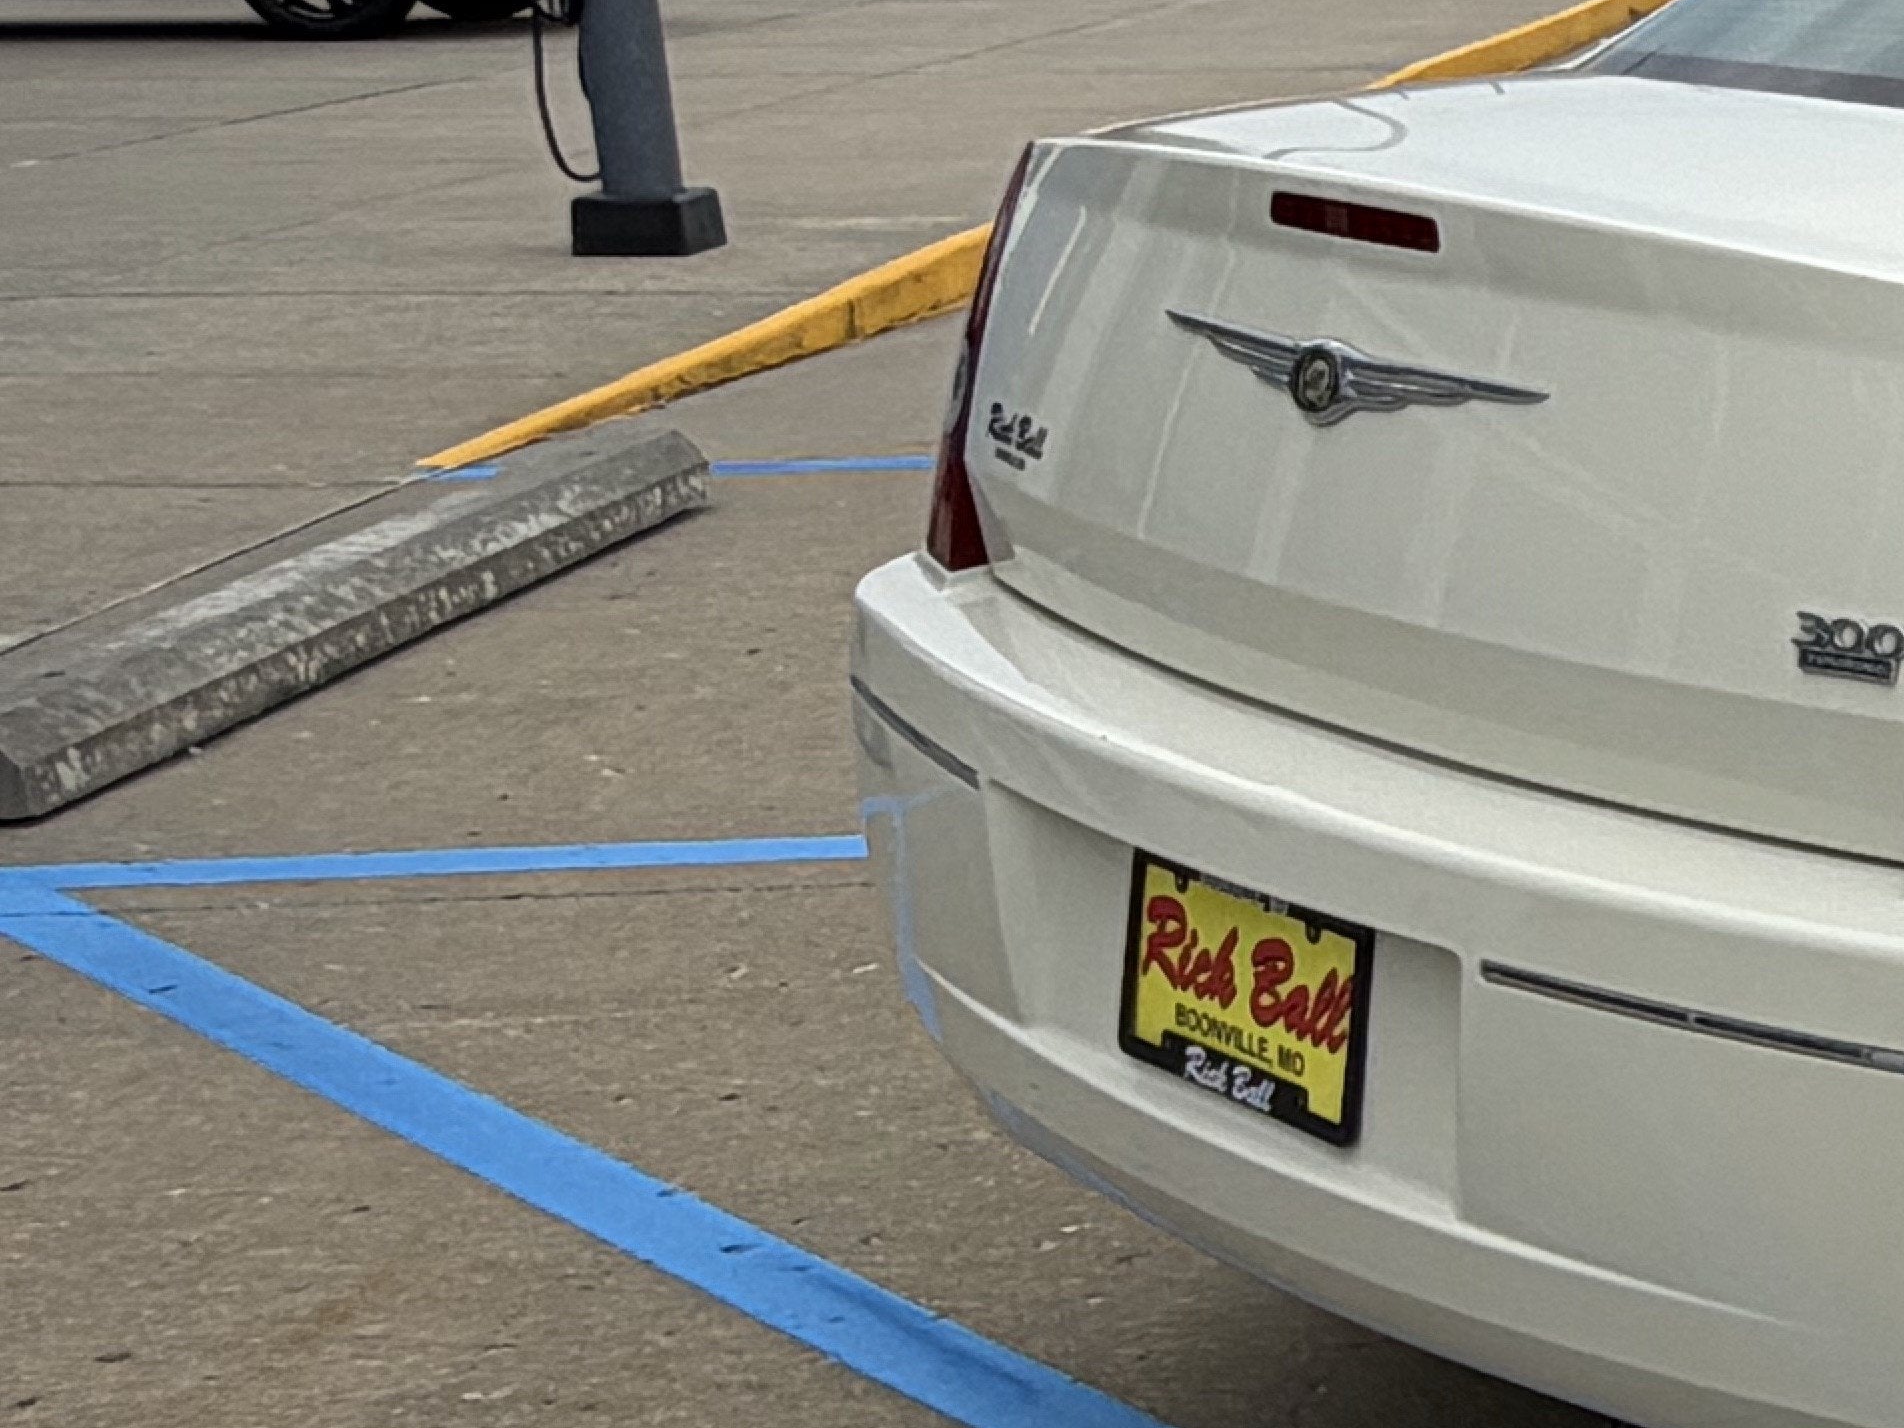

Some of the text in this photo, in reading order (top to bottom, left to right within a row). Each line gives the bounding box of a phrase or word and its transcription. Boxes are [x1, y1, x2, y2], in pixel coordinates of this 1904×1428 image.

[1142, 894, 1354, 1054] Rick Ball
[1183, 1045, 1276, 1112] Rick Ball
[1277, 1044, 1306, 1077] MO
